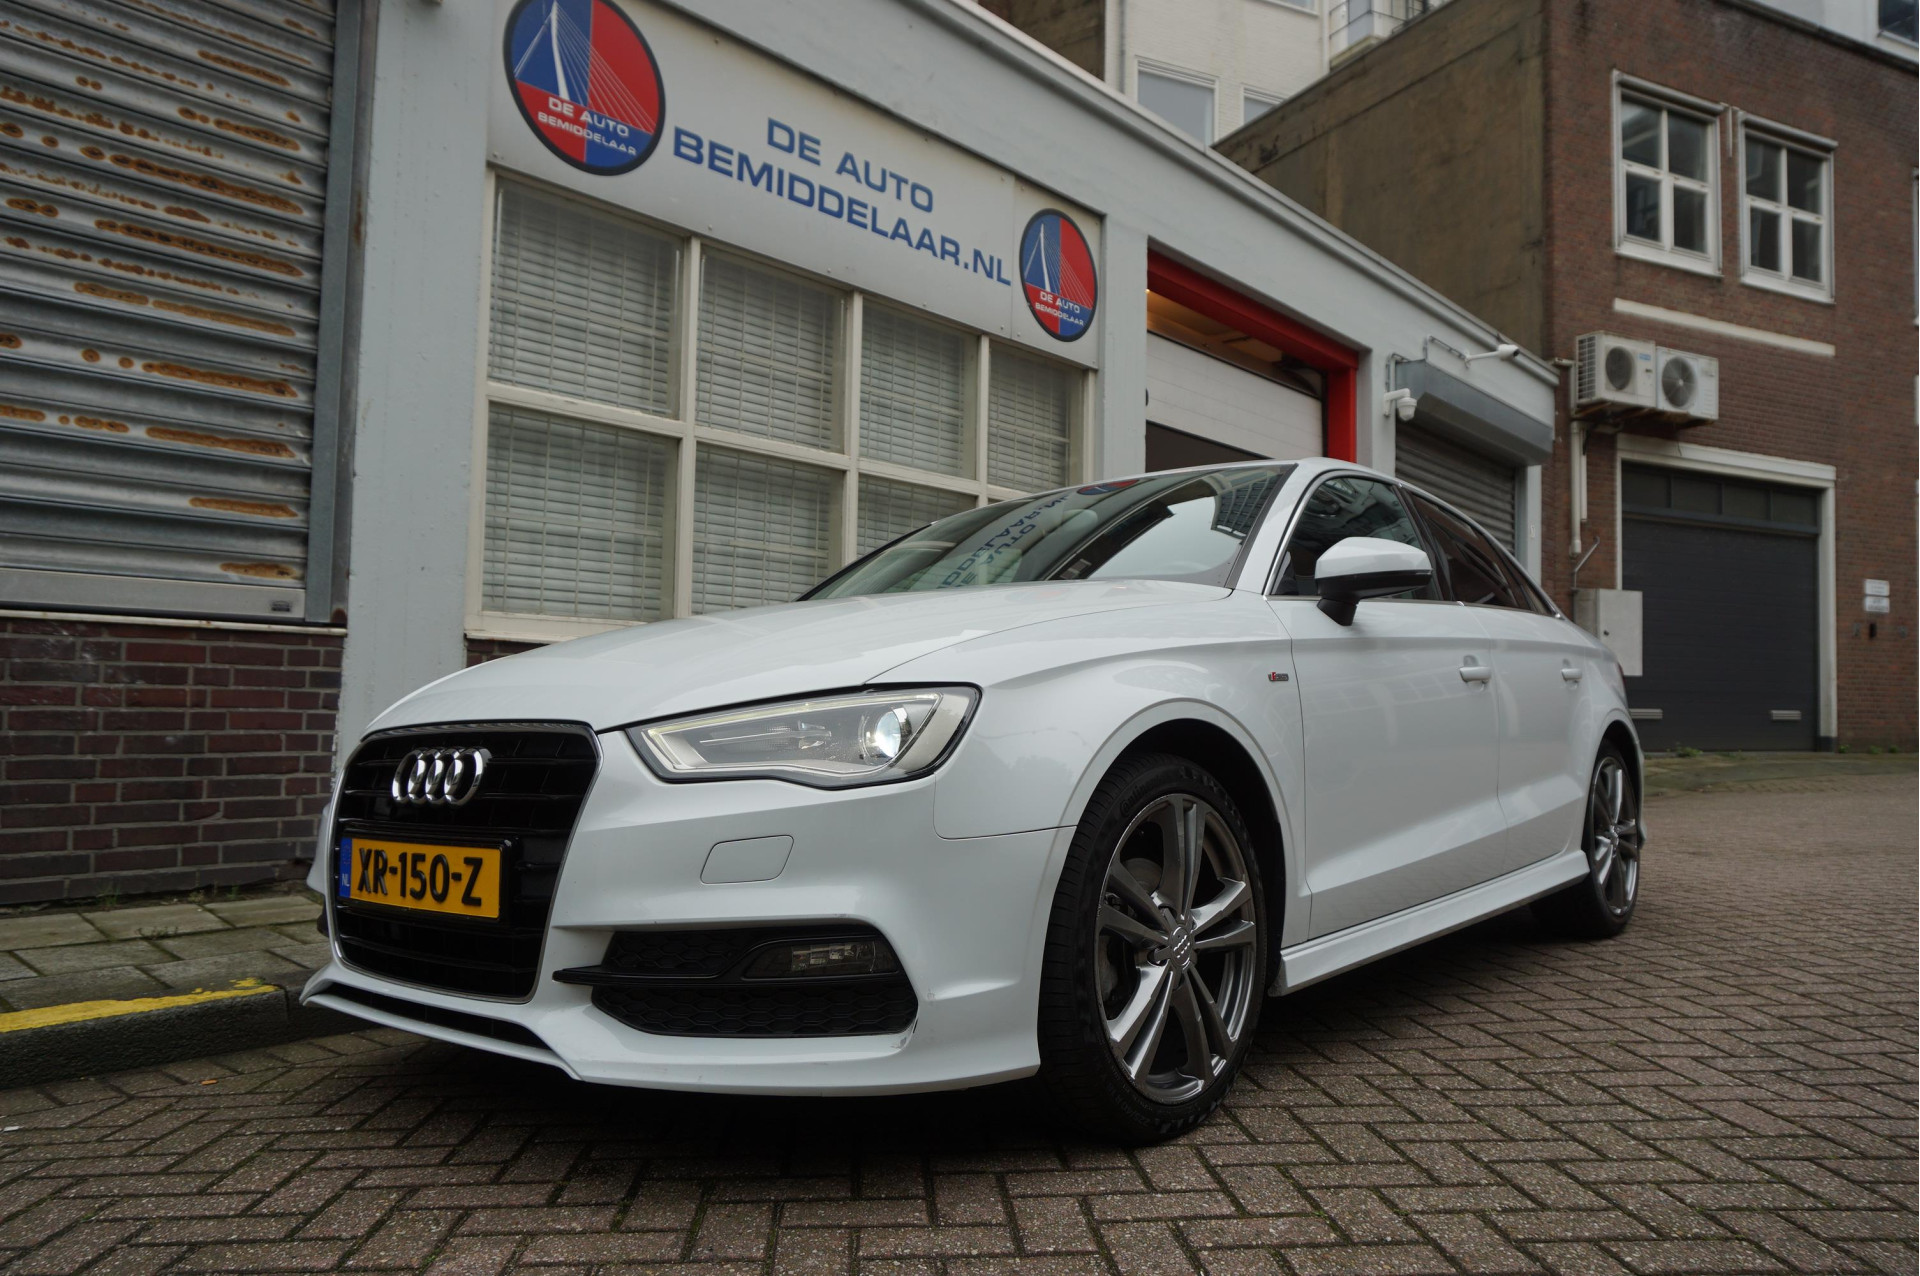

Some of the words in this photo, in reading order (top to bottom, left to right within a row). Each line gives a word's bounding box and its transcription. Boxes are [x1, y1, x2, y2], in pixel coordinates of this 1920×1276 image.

[538, 111, 637, 156] BEMIDDELAAR
[548, 96, 574, 117] DE
[580, 110, 630, 137] AUTO
[767, 117, 821, 166] DE
[835, 151, 933, 213] AUTO
[673, 126, 1011, 286] BEMIDDELAAR.NL
[1035, 302, 1084, 326] BEMIDDELAAR
[1040, 291, 1053, 304] DE
[1055, 298, 1080, 314] AUTO
[357, 847, 483, 907] XR-150-Z
